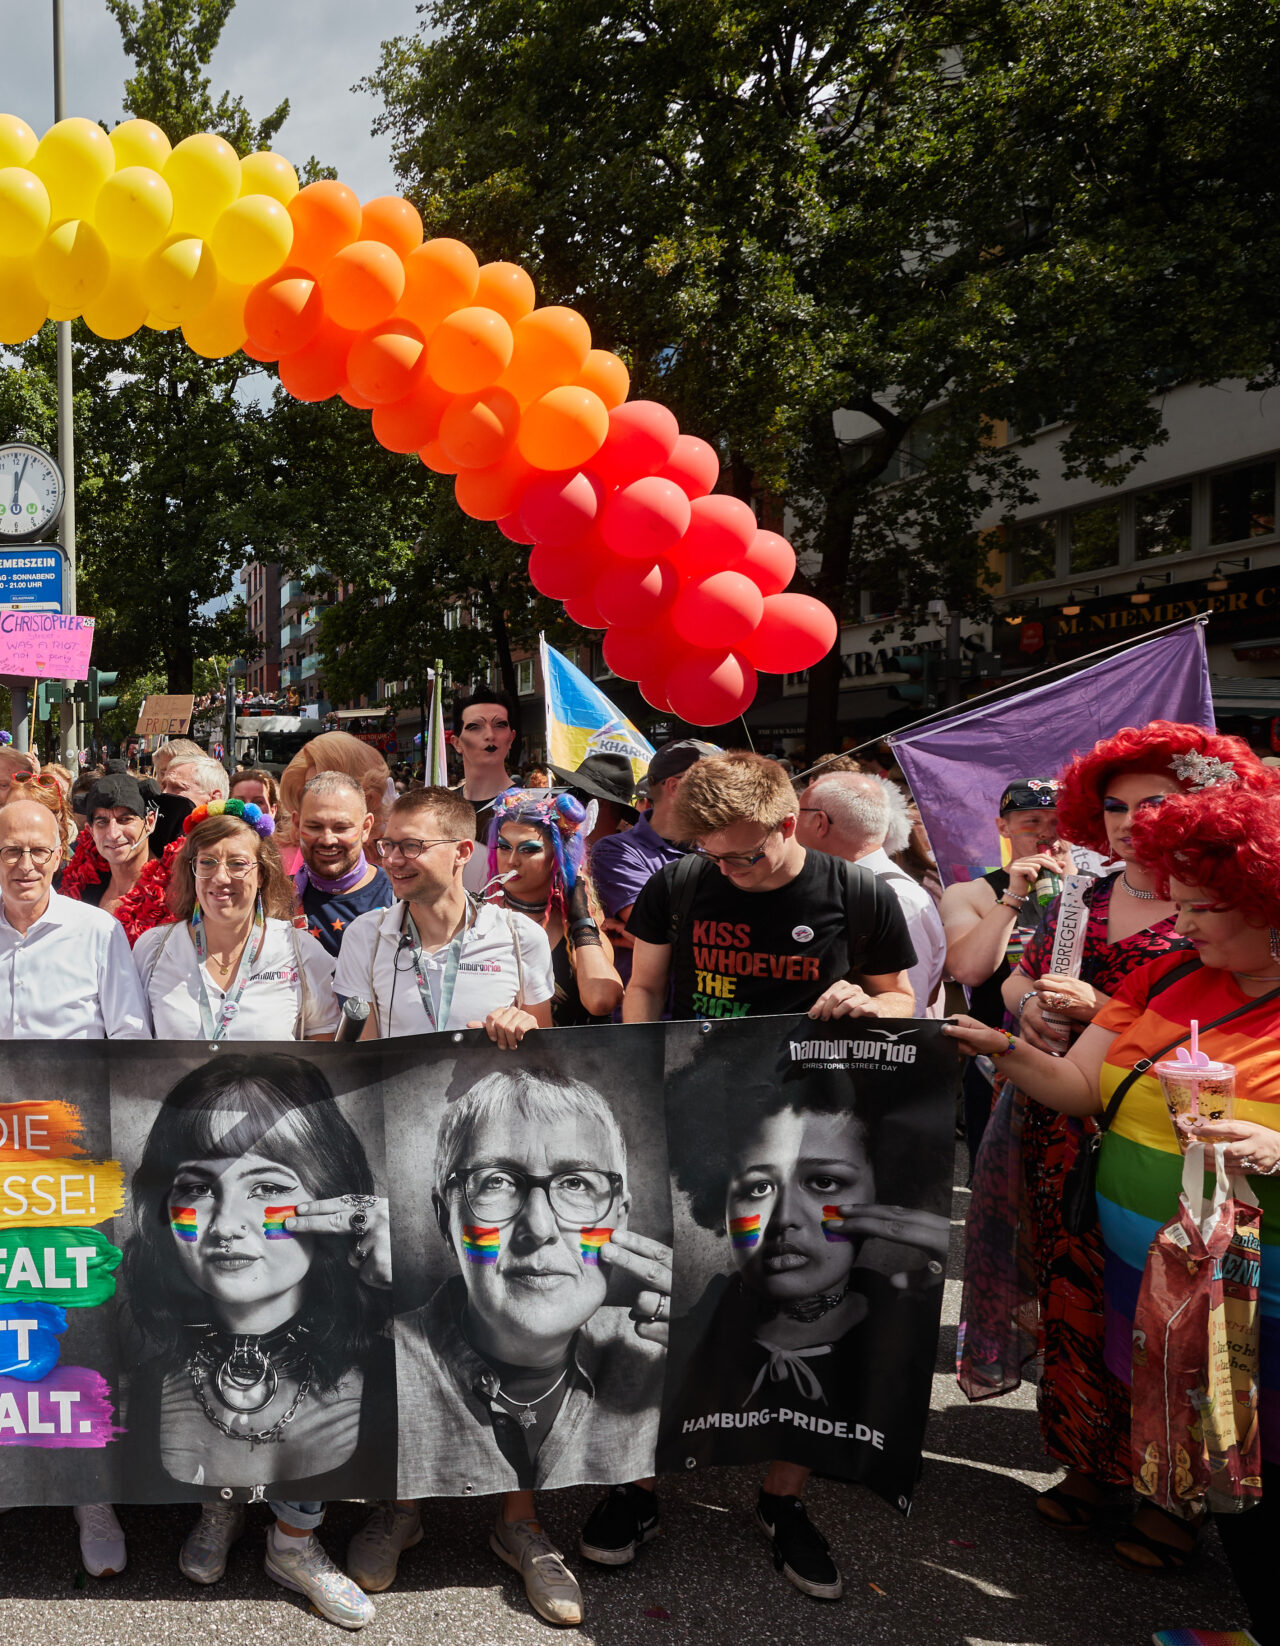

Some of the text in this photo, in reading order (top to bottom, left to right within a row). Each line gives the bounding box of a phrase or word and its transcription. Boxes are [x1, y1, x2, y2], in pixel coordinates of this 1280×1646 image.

[9, 581, 26, 589] 21.00
[1090, 593, 1248, 632] NIEMEYER
[1256, 587, 1280, 608] C
[1, 613, 83, 633] CHRISTOPHER
[6, 641, 34, 650] WAS
[52, 641, 80, 650] RIOT
[49, 653, 72, 664] party
[692, 919, 751, 949] KISS
[692, 946, 820, 981] WHOEVER
[694, 969, 738, 999] THE
[691, 992, 752, 1018] FUCK
[789, 1039, 918, 1064] hamburgpride
[802, 1062, 850, 1070] CHRISTOPHER
[881, 1064, 898, 1072] DAY
[681, 1407, 885, 1451] HAMBURG-PRIDE.DE
